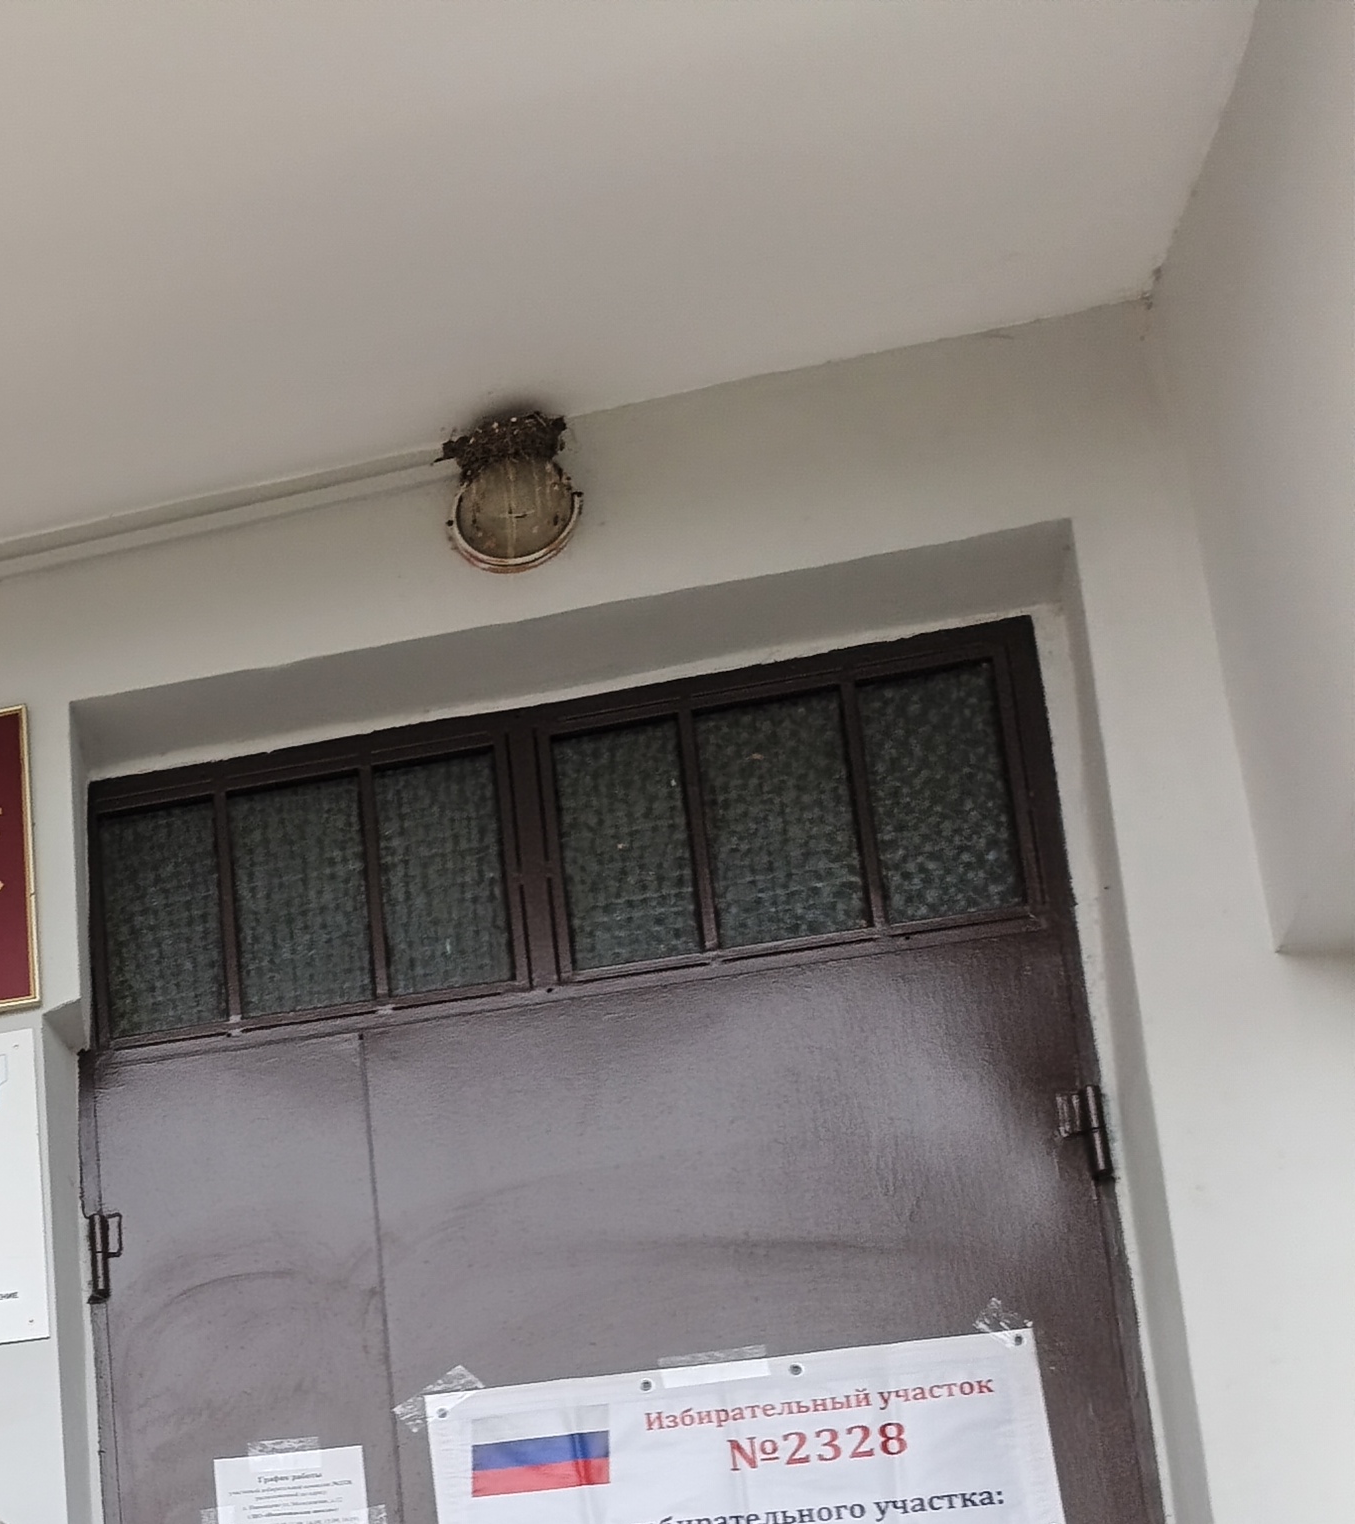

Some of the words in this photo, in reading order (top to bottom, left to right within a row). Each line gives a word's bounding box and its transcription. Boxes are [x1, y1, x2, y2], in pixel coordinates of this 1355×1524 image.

[645, 1388, 872, 1431] Избирательный
[878, 1378, 995, 1410] участок
[727, 1421, 908, 1472] №2328
[874, 1490, 1004, 1522] участка:
